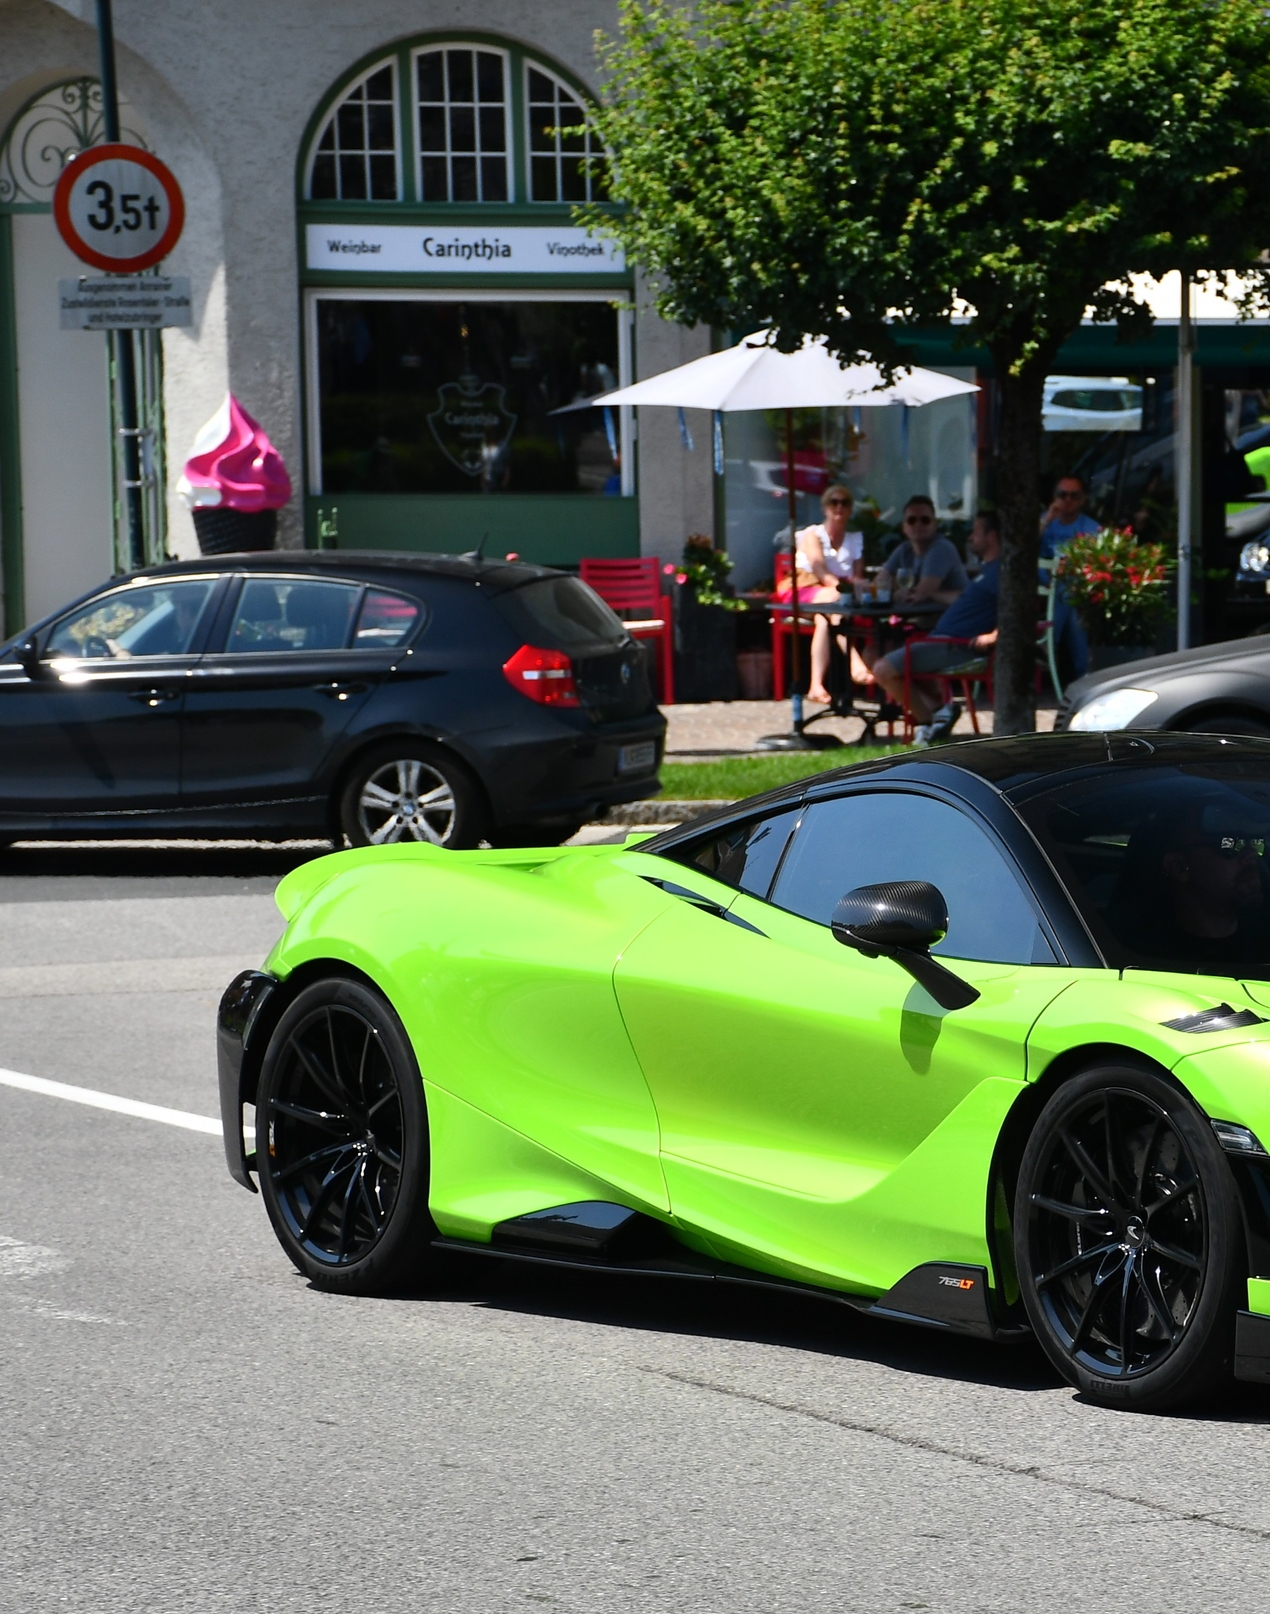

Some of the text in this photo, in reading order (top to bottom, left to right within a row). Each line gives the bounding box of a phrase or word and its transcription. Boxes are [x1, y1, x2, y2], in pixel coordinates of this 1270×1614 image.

[86, 180, 160, 234] 3,5t
[327, 237, 604, 260] Weinbar Carinthia Vinothek
[938, 1276, 975, 1290] 765LT
